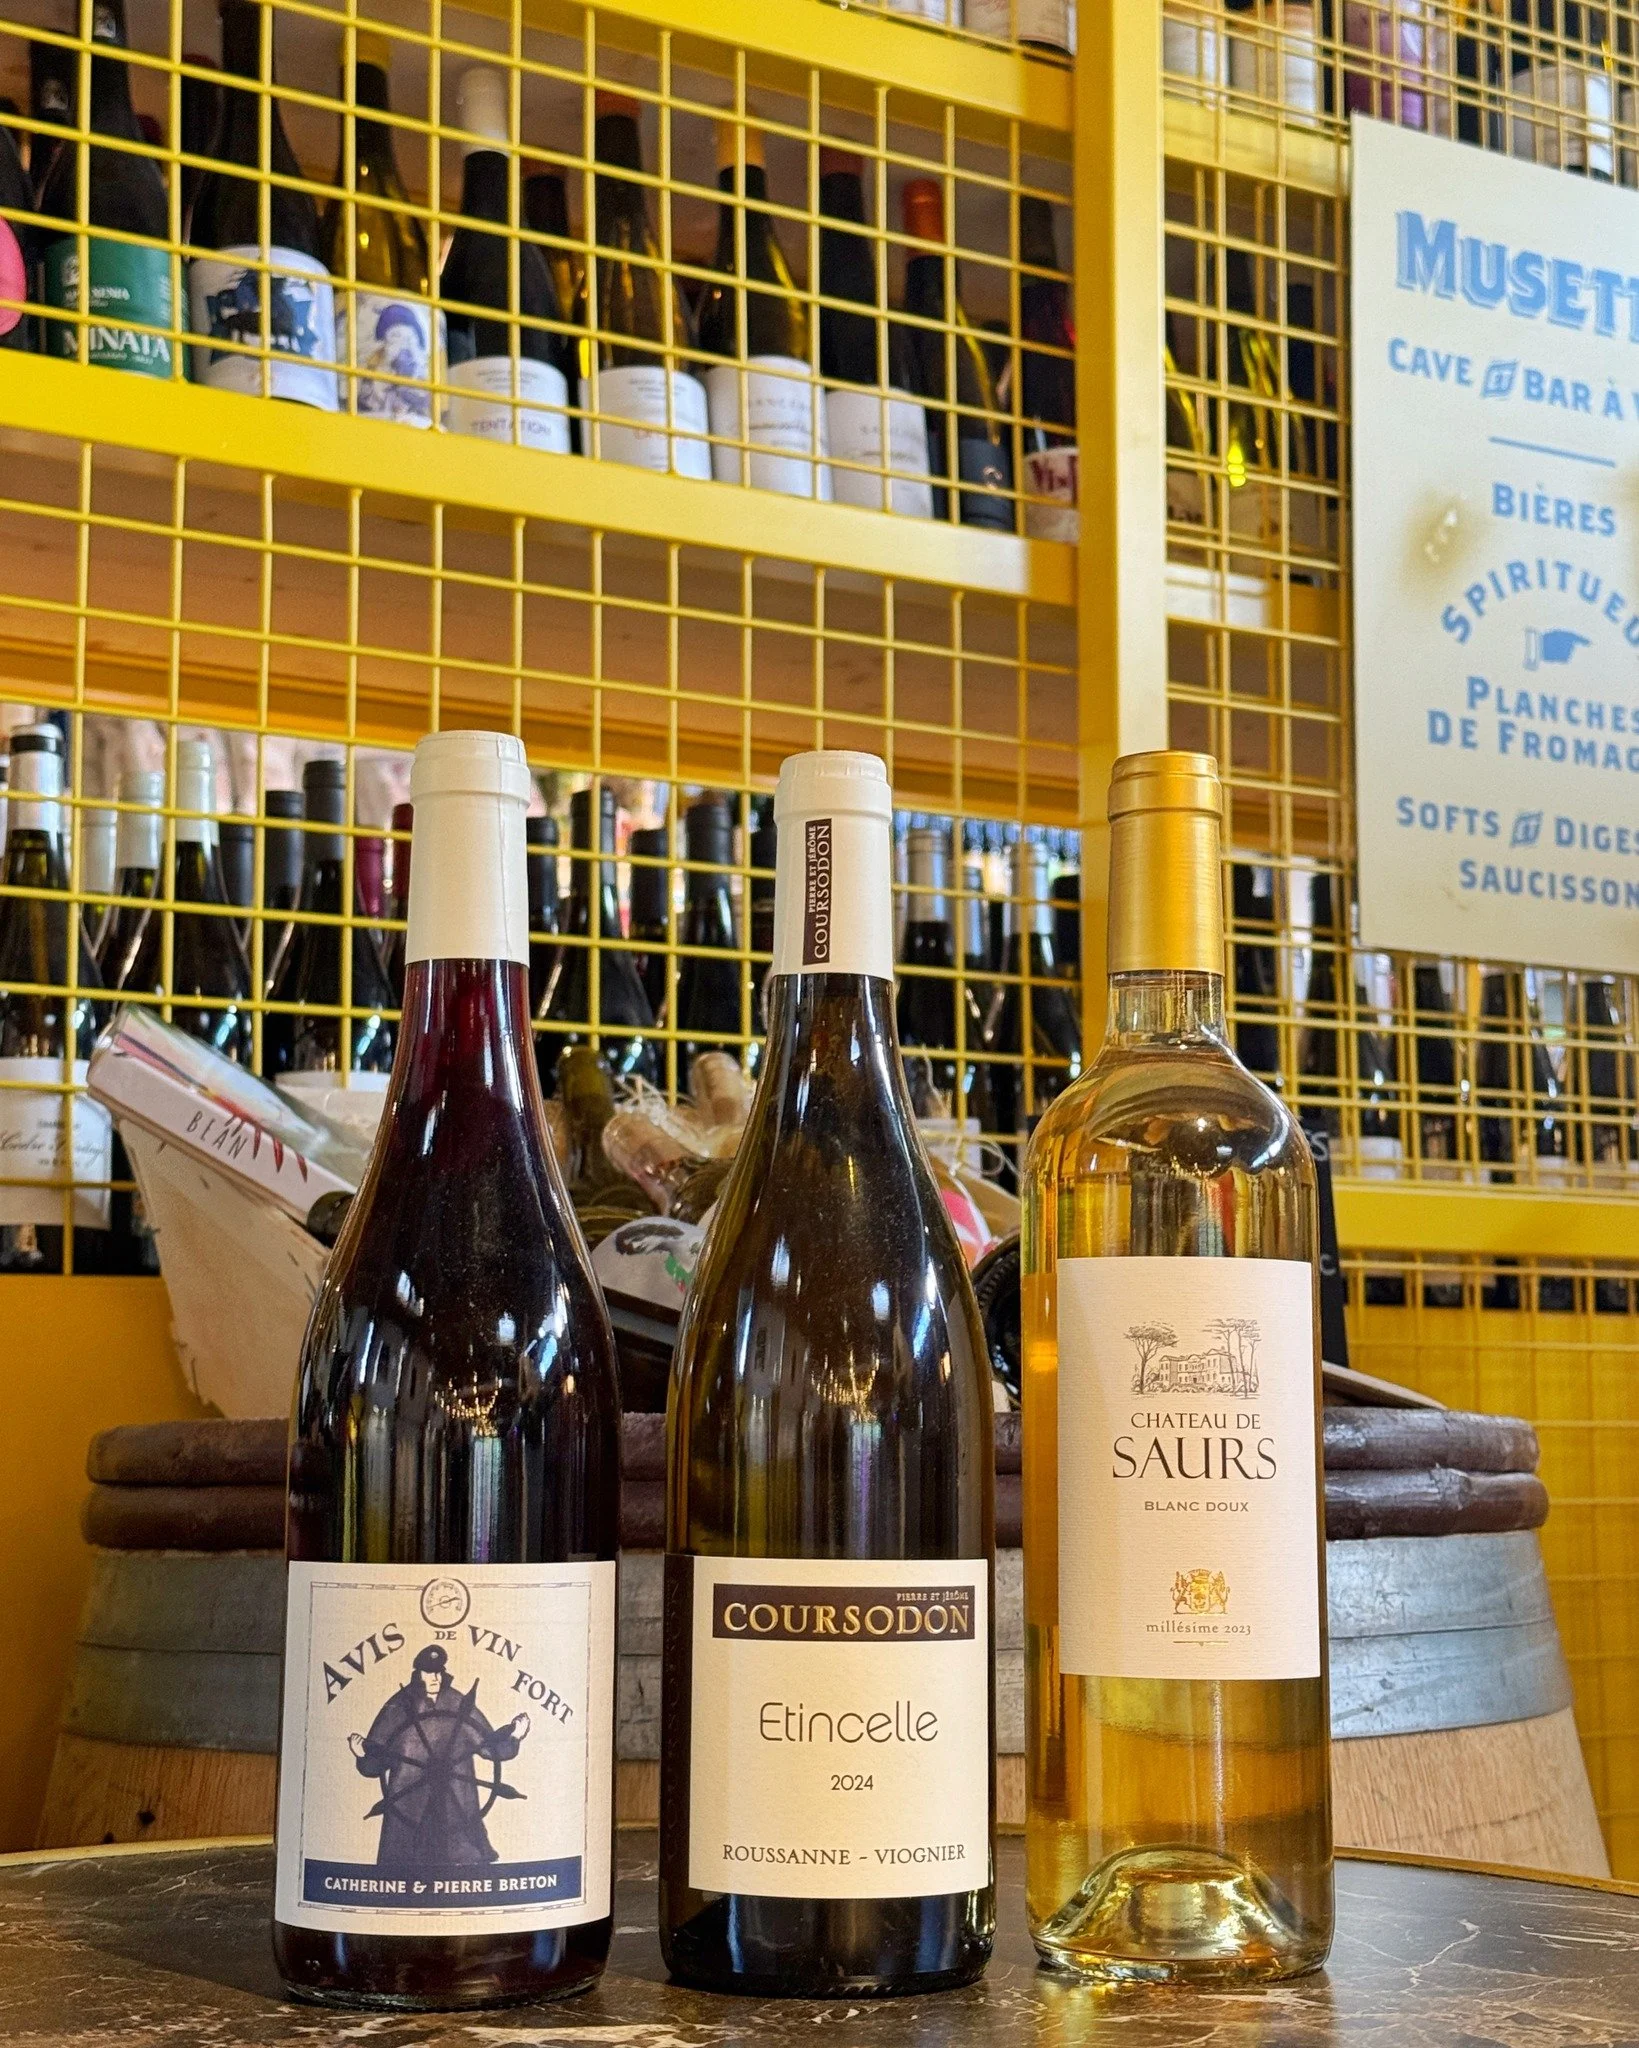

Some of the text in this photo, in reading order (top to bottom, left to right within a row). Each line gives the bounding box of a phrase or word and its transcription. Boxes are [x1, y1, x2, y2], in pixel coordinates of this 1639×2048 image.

[1387, 337, 1473, 387] CAVE
[1523, 368, 1591, 415] BAR
[1602, 376, 1624, 421] À
[1492, 481, 1617, 538] BIÈRES
[1428, 708, 1478, 749] DE
[1396, 795, 1500, 839] SOFTS
[807, 825, 818, 914] PIERRE ET JÉRÔME
[814, 824, 831, 960] COURSODON
[1130, 1412, 1262, 1430] CHATEAU DE
[1112, 1435, 1278, 1481] SAURS
[1144, 1501, 1250, 1513] BLANC DOUX
[896, 1592, 928, 1602] PIERRE
[930, 1592, 941, 1601] ET
[723, 1602, 970, 1636] COURSODON
[1146, 1620, 1252, 1636] millésime 2023
[323, 1622, 574, 1726] AVIS DE VIN FORT
[759, 1700, 939, 1744] Etincelle
[830, 1774, 874, 1792] 2024
[722, 1844, 851, 1865] ROUSSANNE
[874, 1843, 966, 1865] VIOGNIER
[324, 1874, 558, 1894] CATHERINE & PIERRE BRETON
